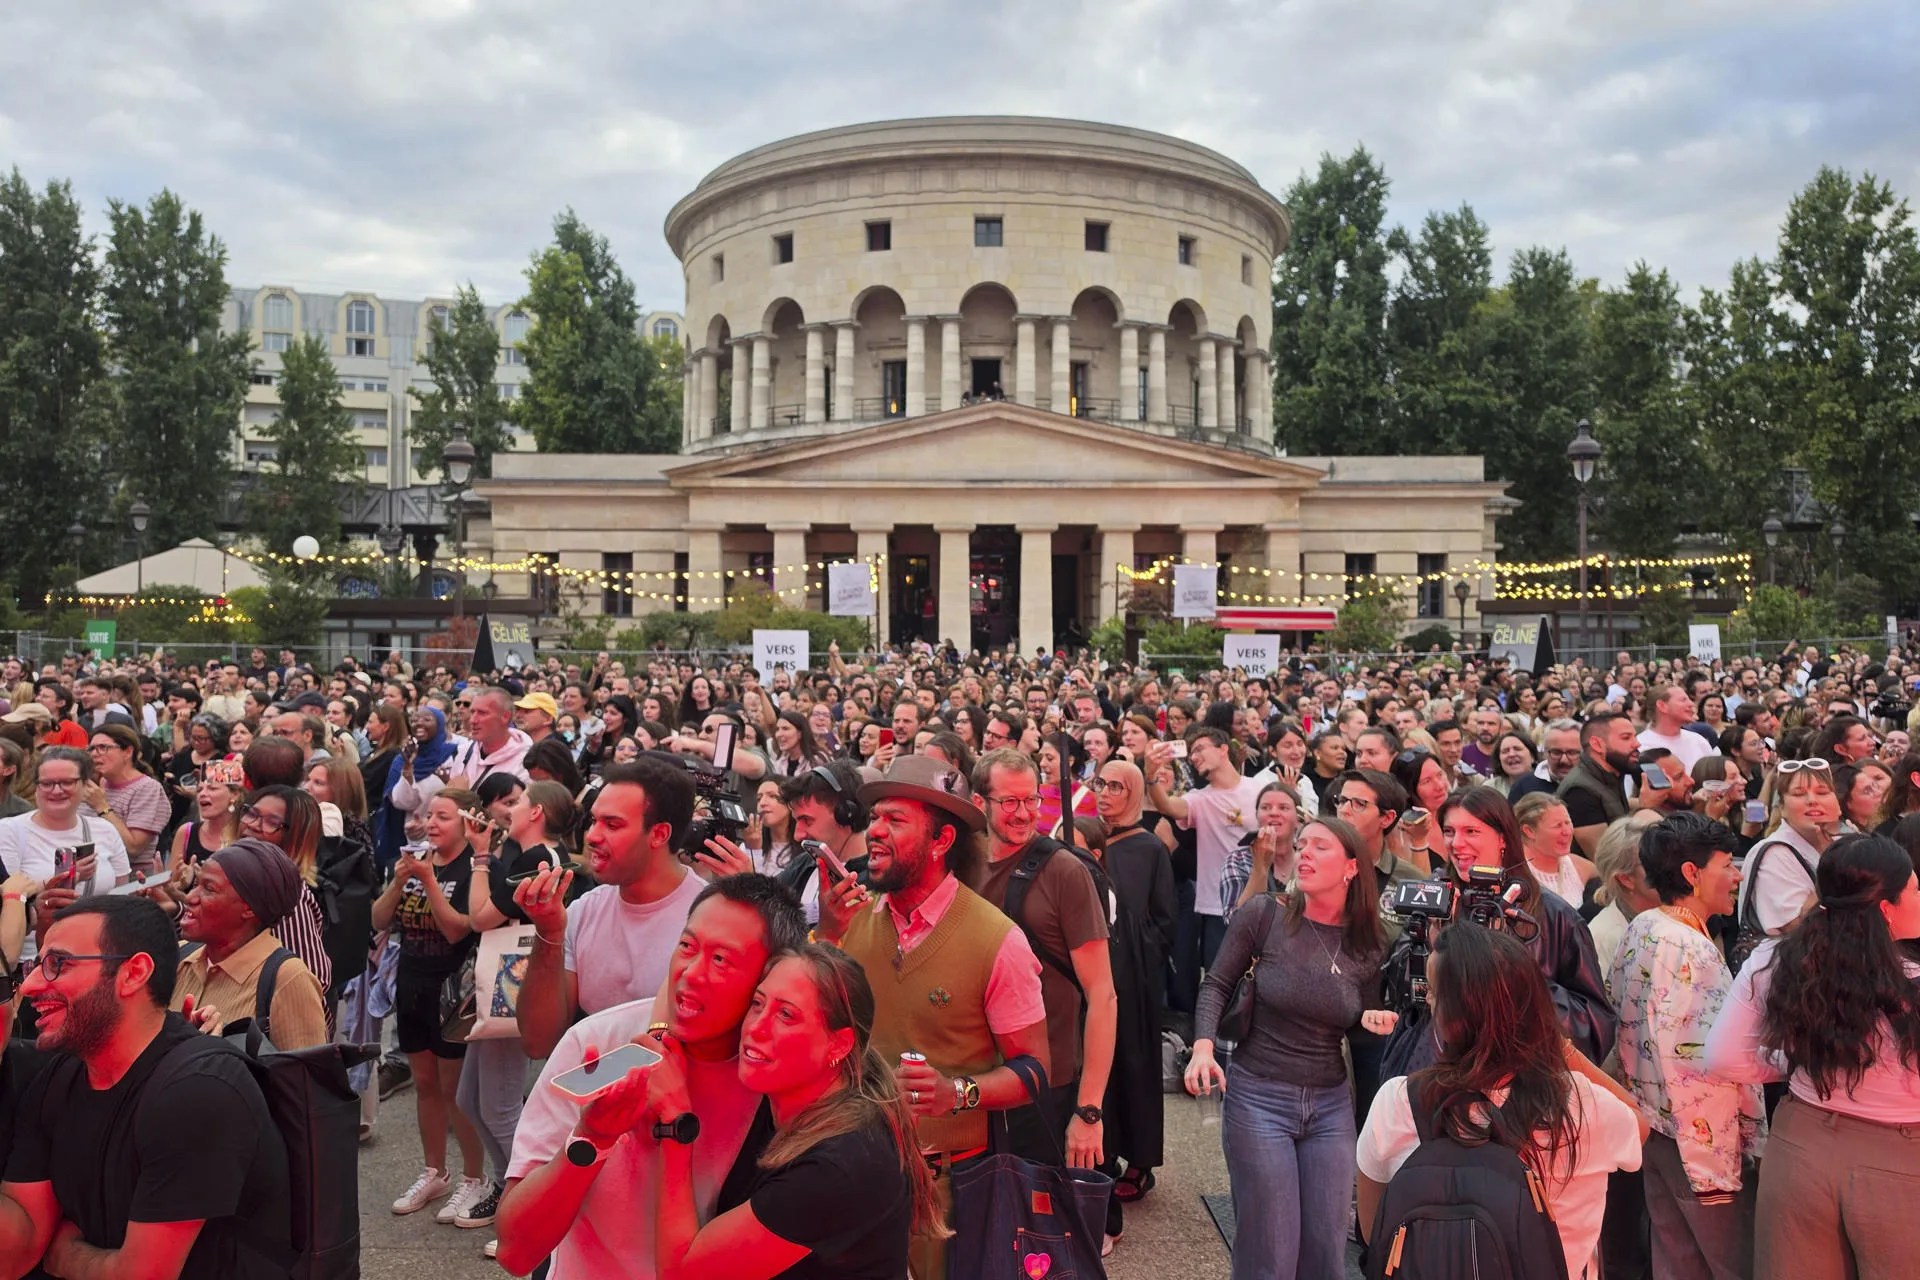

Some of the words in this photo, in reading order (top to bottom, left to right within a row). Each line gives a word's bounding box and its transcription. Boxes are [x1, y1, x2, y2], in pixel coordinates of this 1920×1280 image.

[89, 631, 109, 644] SORTIE
[1697, 639, 1714, 648] VERS
[765, 644, 795, 655] VERS
[1236, 648, 1266, 658] VERS
[1244, 664, 1266, 674] ARS
